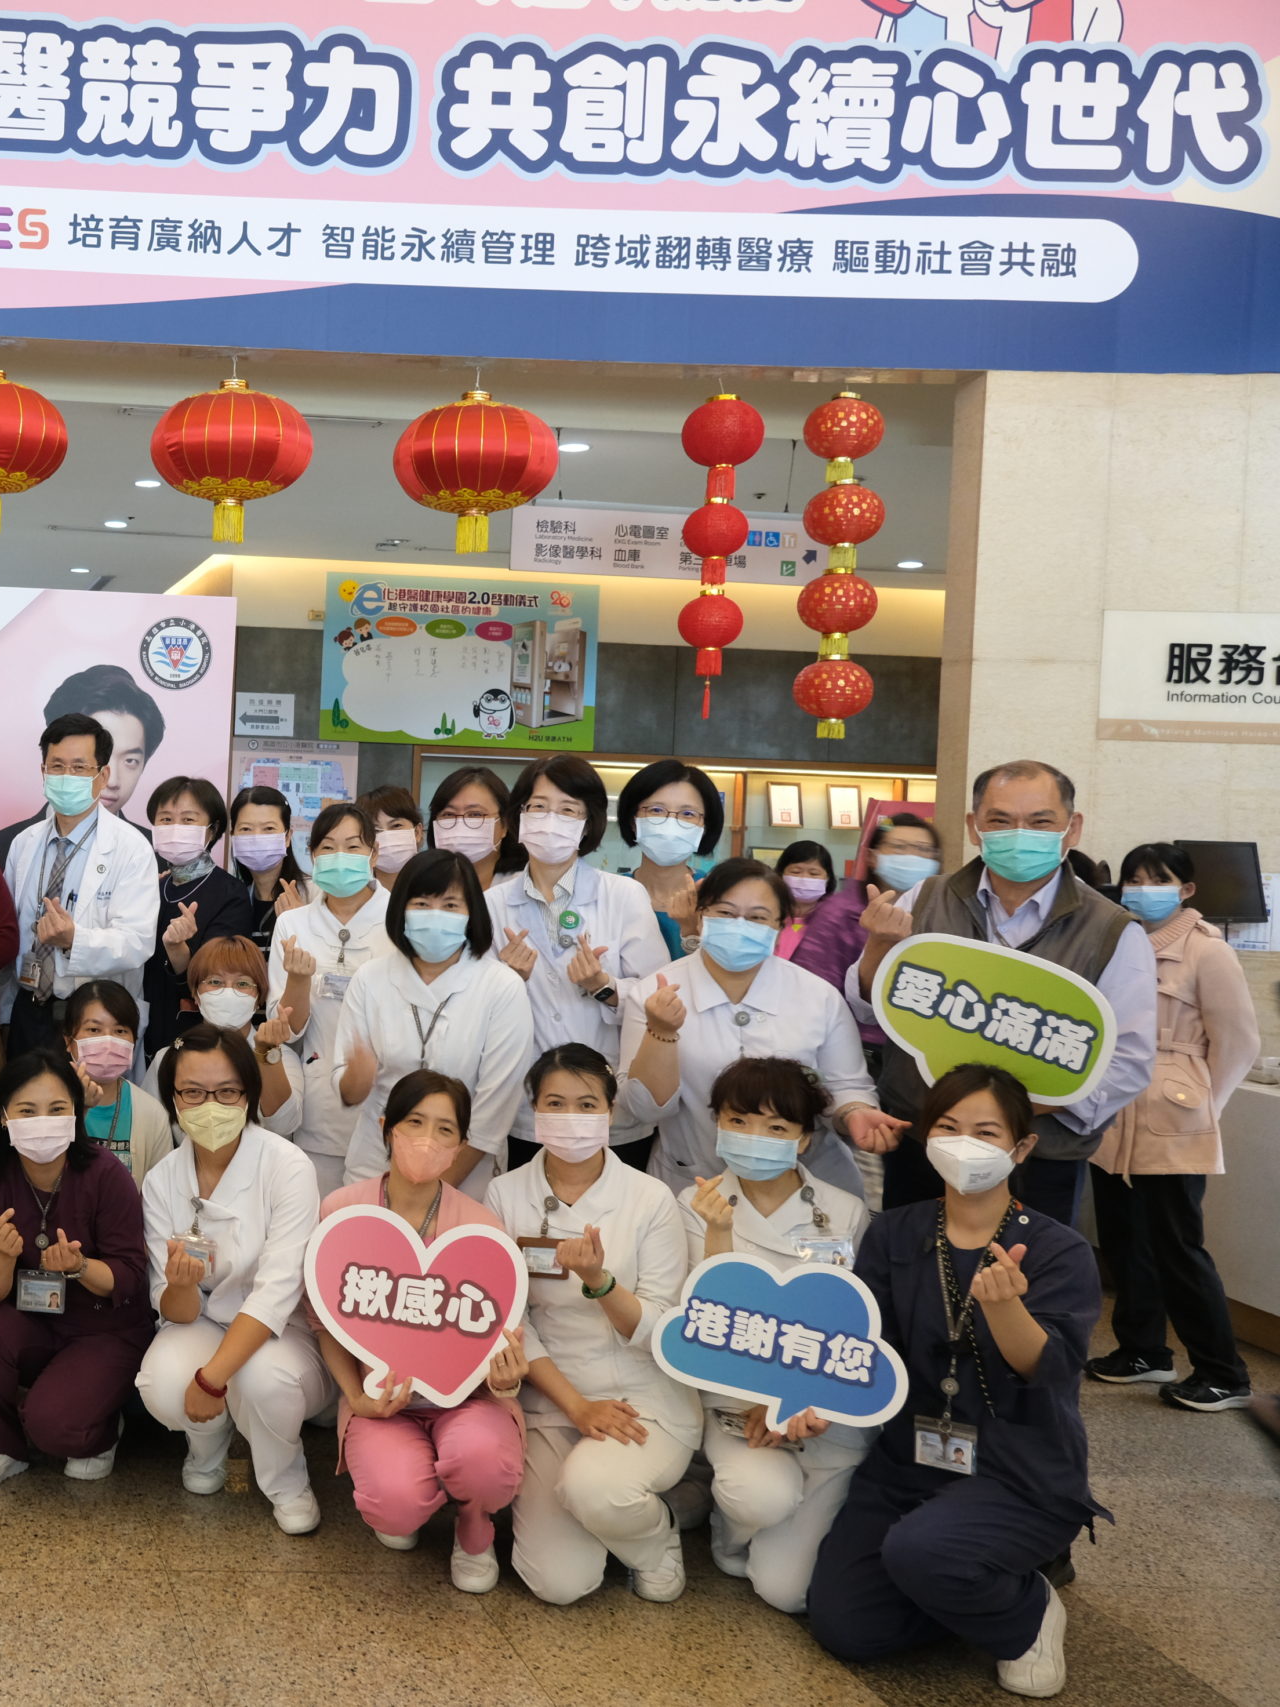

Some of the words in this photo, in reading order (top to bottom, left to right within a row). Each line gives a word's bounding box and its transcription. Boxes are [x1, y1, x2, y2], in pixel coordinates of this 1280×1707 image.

[448, 52, 1251, 174] 共創永續心世代
[68, 213, 302, 258] 培育廣納人才
[321, 225, 556, 268] 智能永續管理
[574, 232, 815, 275] 跨域翻轉醫療
[832, 238, 1079, 279] 驅動社會共融
[536, 520, 577, 535] 檢驗科
[614, 524, 670, 540] 心電圖室
[535, 543, 603, 560] 影像醫學科
[614, 548, 641, 562] 血庫
[1166, 643, 1280, 686] 服務
[1166, 690, 1247, 704] Information
[891, 966, 1094, 1071] 愛心滿滿
[341, 1265, 497, 1333] 揪感心
[683, 1299, 875, 1383] 港謝有您
